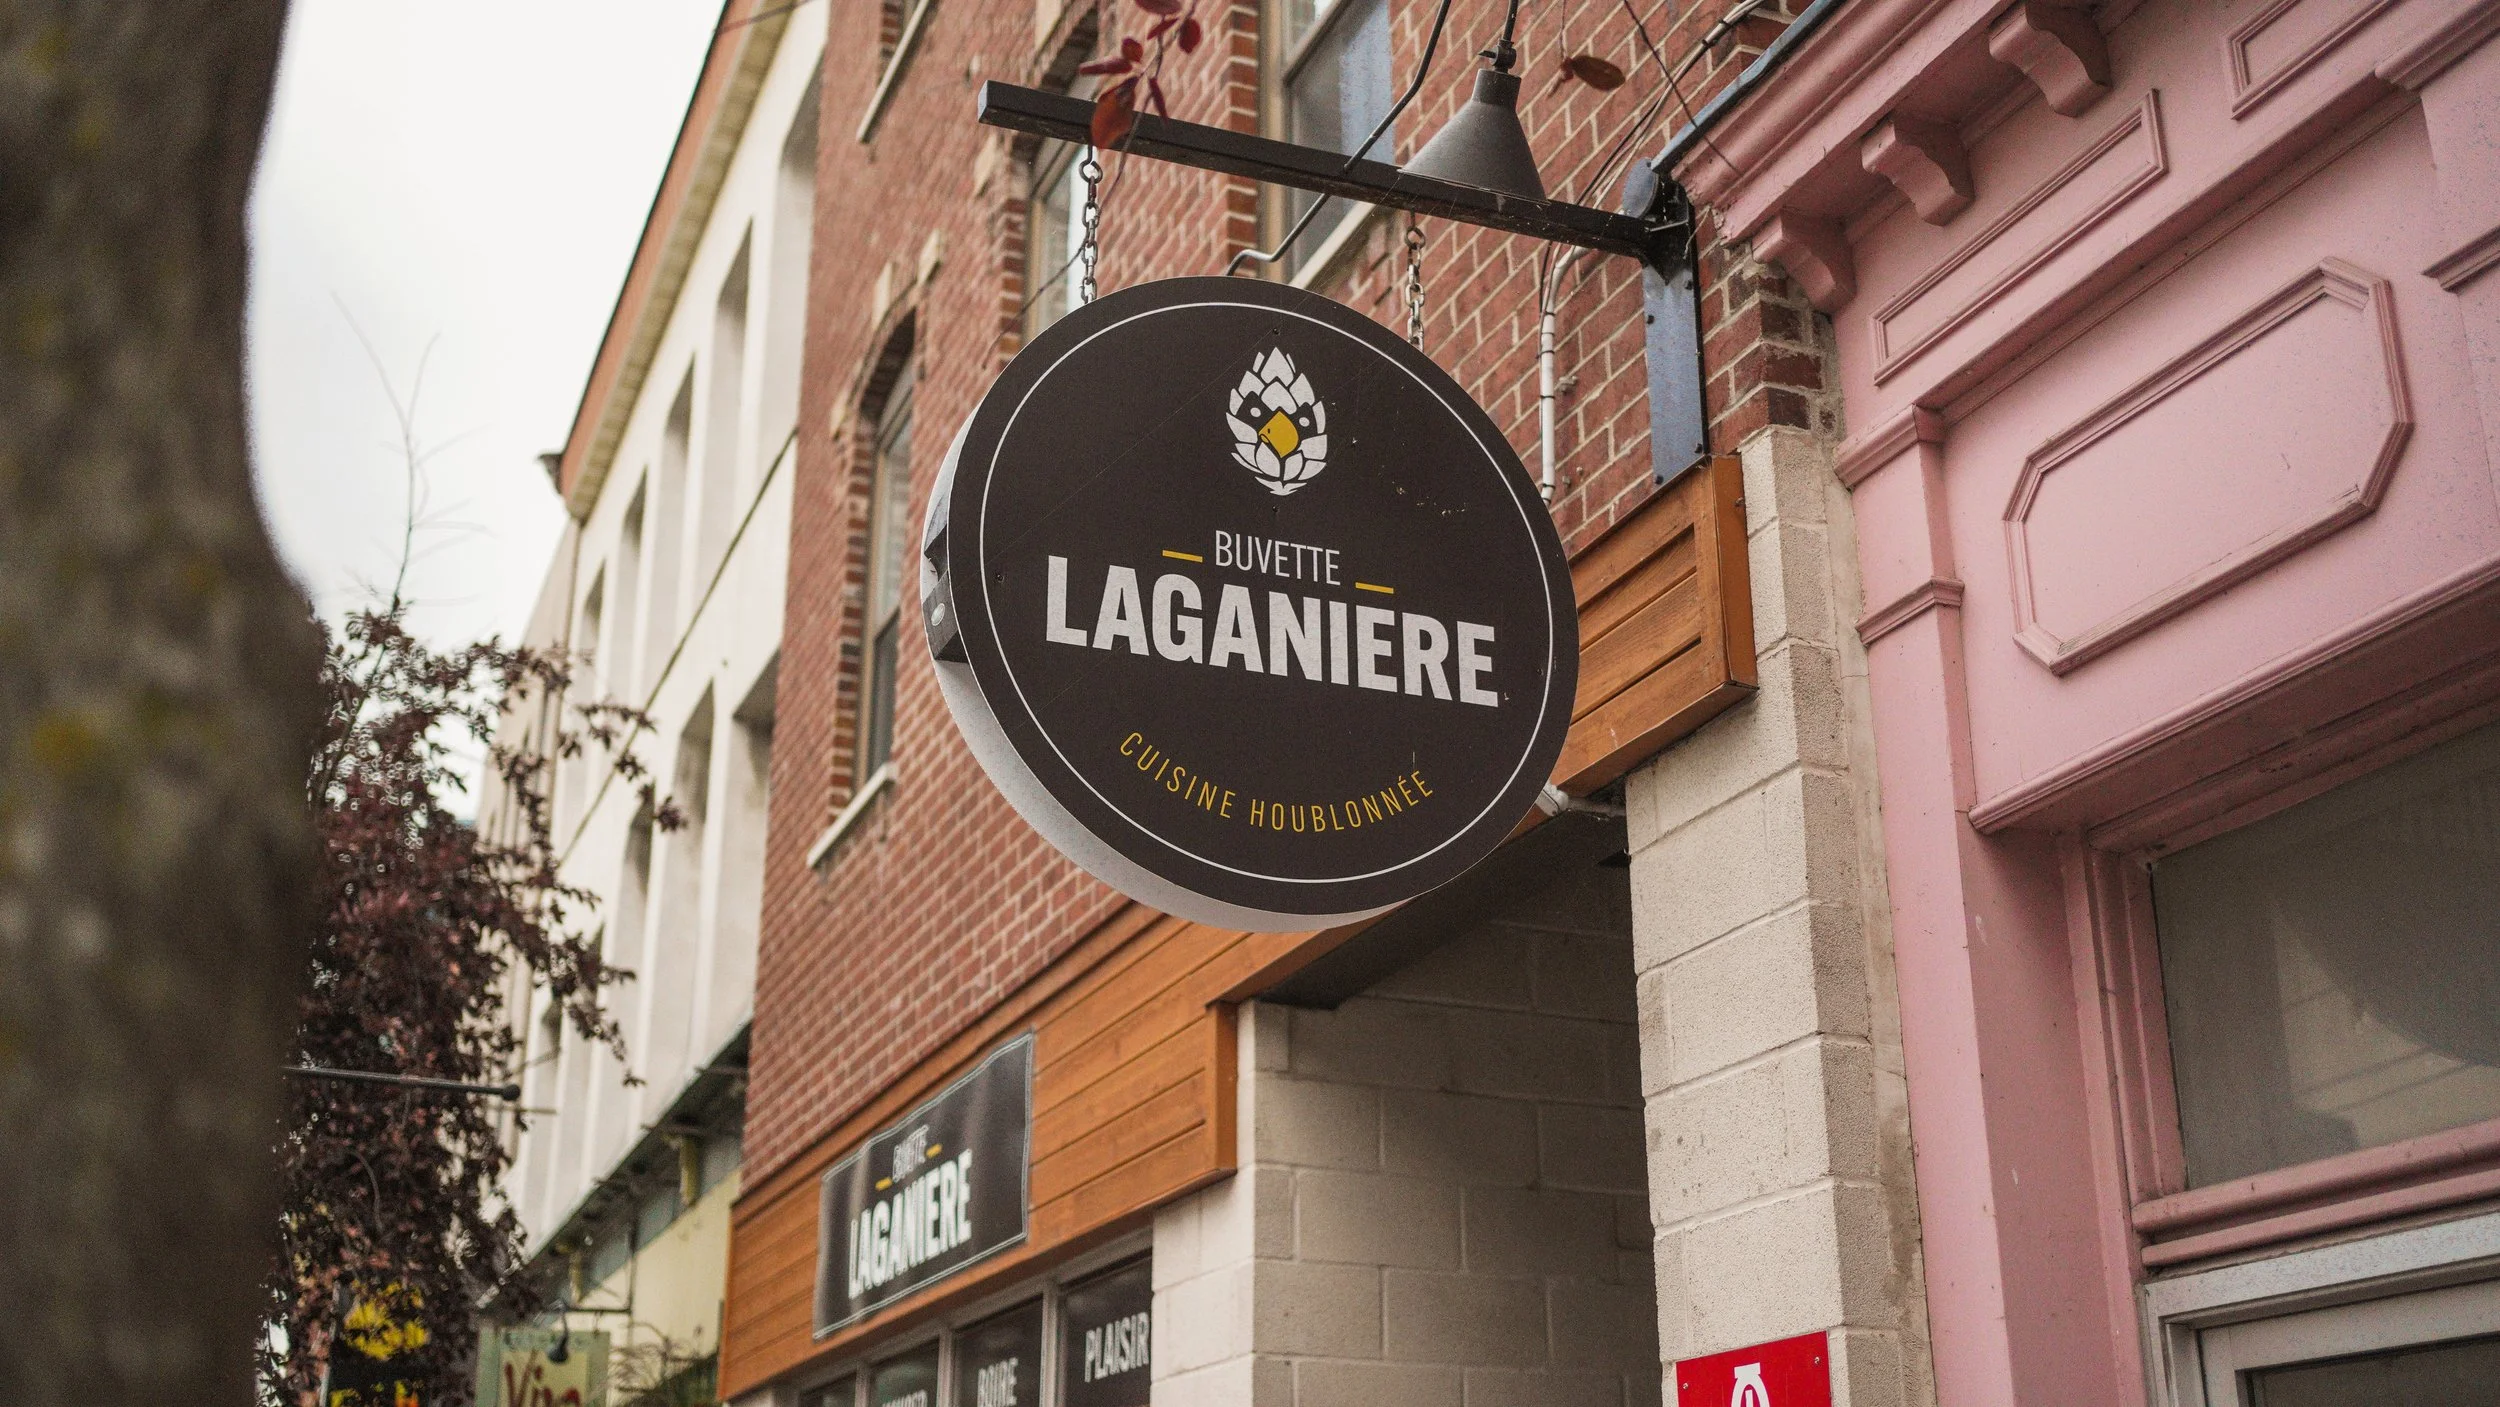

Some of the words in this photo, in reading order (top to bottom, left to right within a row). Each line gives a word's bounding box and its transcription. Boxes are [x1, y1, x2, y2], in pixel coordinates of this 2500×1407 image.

[1214, 530, 1342, 586] BUVETTE
[1045, 555, 1499, 708] LAGANIERE
[1119, 731, 1237, 819] CUISINE
[1249, 769, 1434, 833] HOUBLONNÉE
[848, 1148, 973, 1300] LAGANIERE
[1084, 1311, 1150, 1383] PLAISIR
